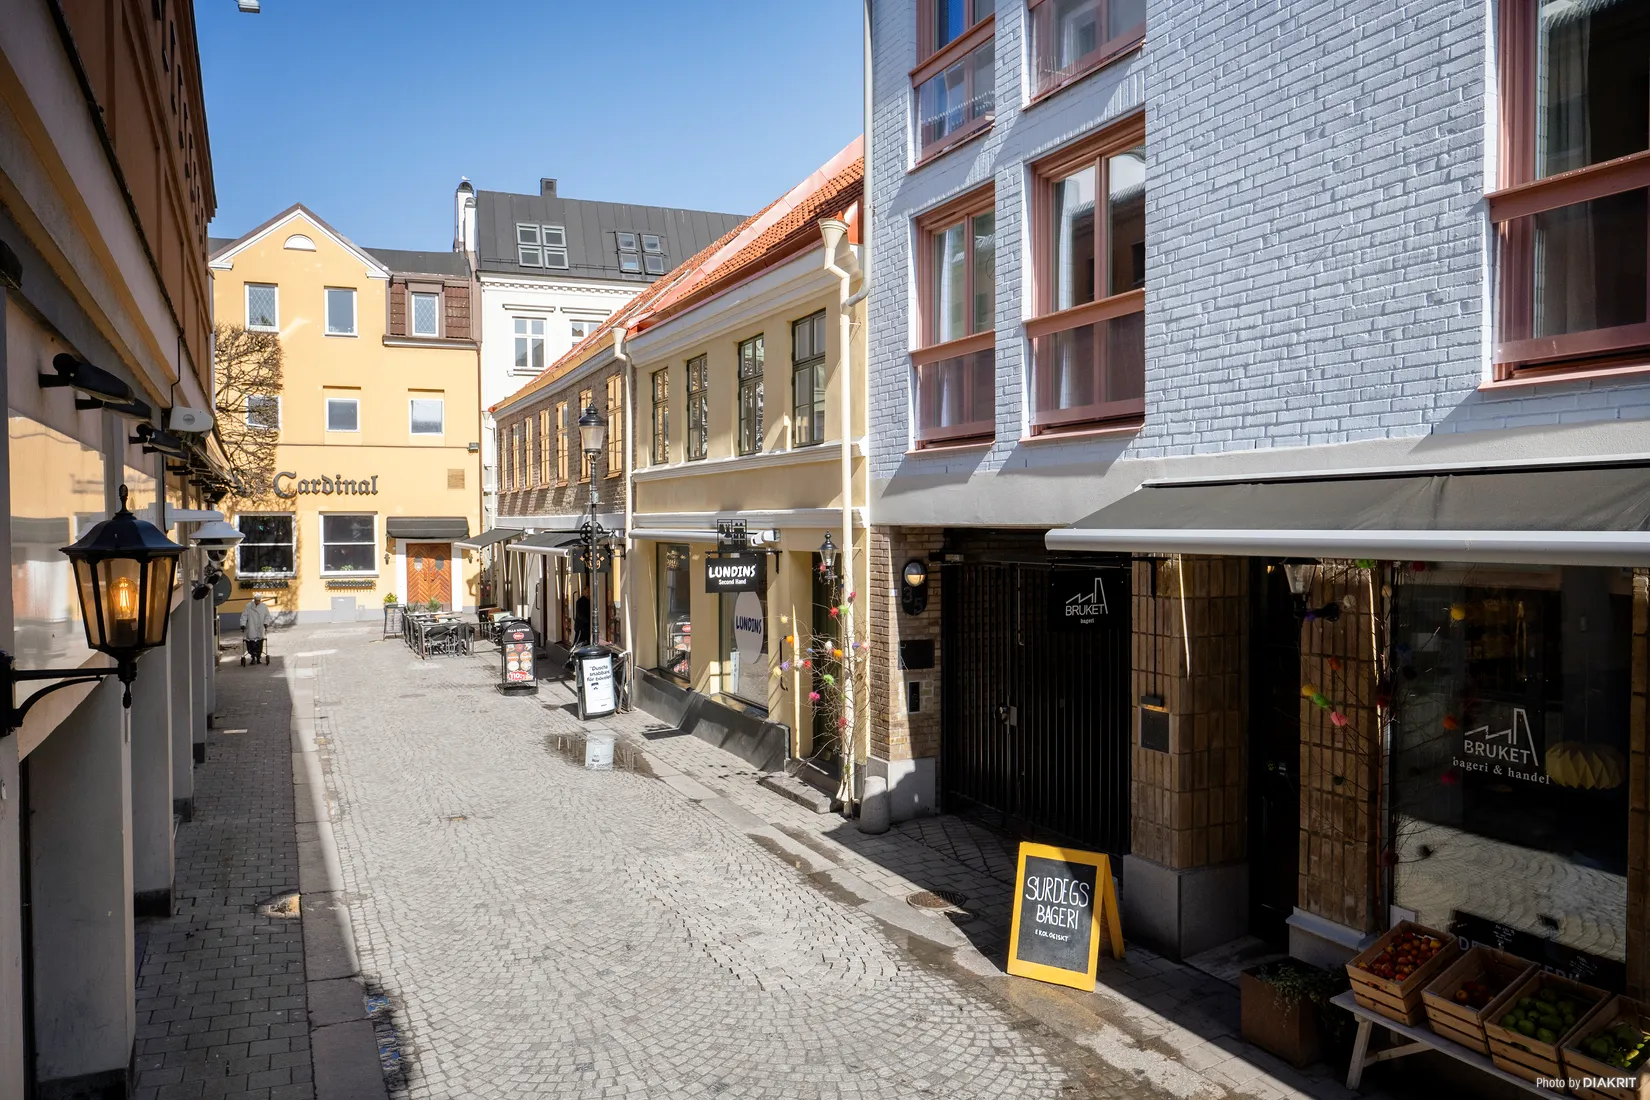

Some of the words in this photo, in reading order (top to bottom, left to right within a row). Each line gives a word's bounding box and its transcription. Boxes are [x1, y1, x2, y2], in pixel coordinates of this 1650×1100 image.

[273, 471, 379, 499] Cardinal
[708, 565, 756, 579] LUNDINS
[718, 578, 735, 586] Second
[1065, 604, 1105, 616] BRUKET
[736, 615, 762, 635] LUNDINS
[1464, 740, 1531, 764] BRUKET
[1453, 757, 1489, 772] bageri
[1493, 764, 1503, 775] &
[1508, 767, 1550, 785] handel
[1025, 876, 1090, 908] SURDEGS
[1035, 904, 1079, 930] BAGERI
